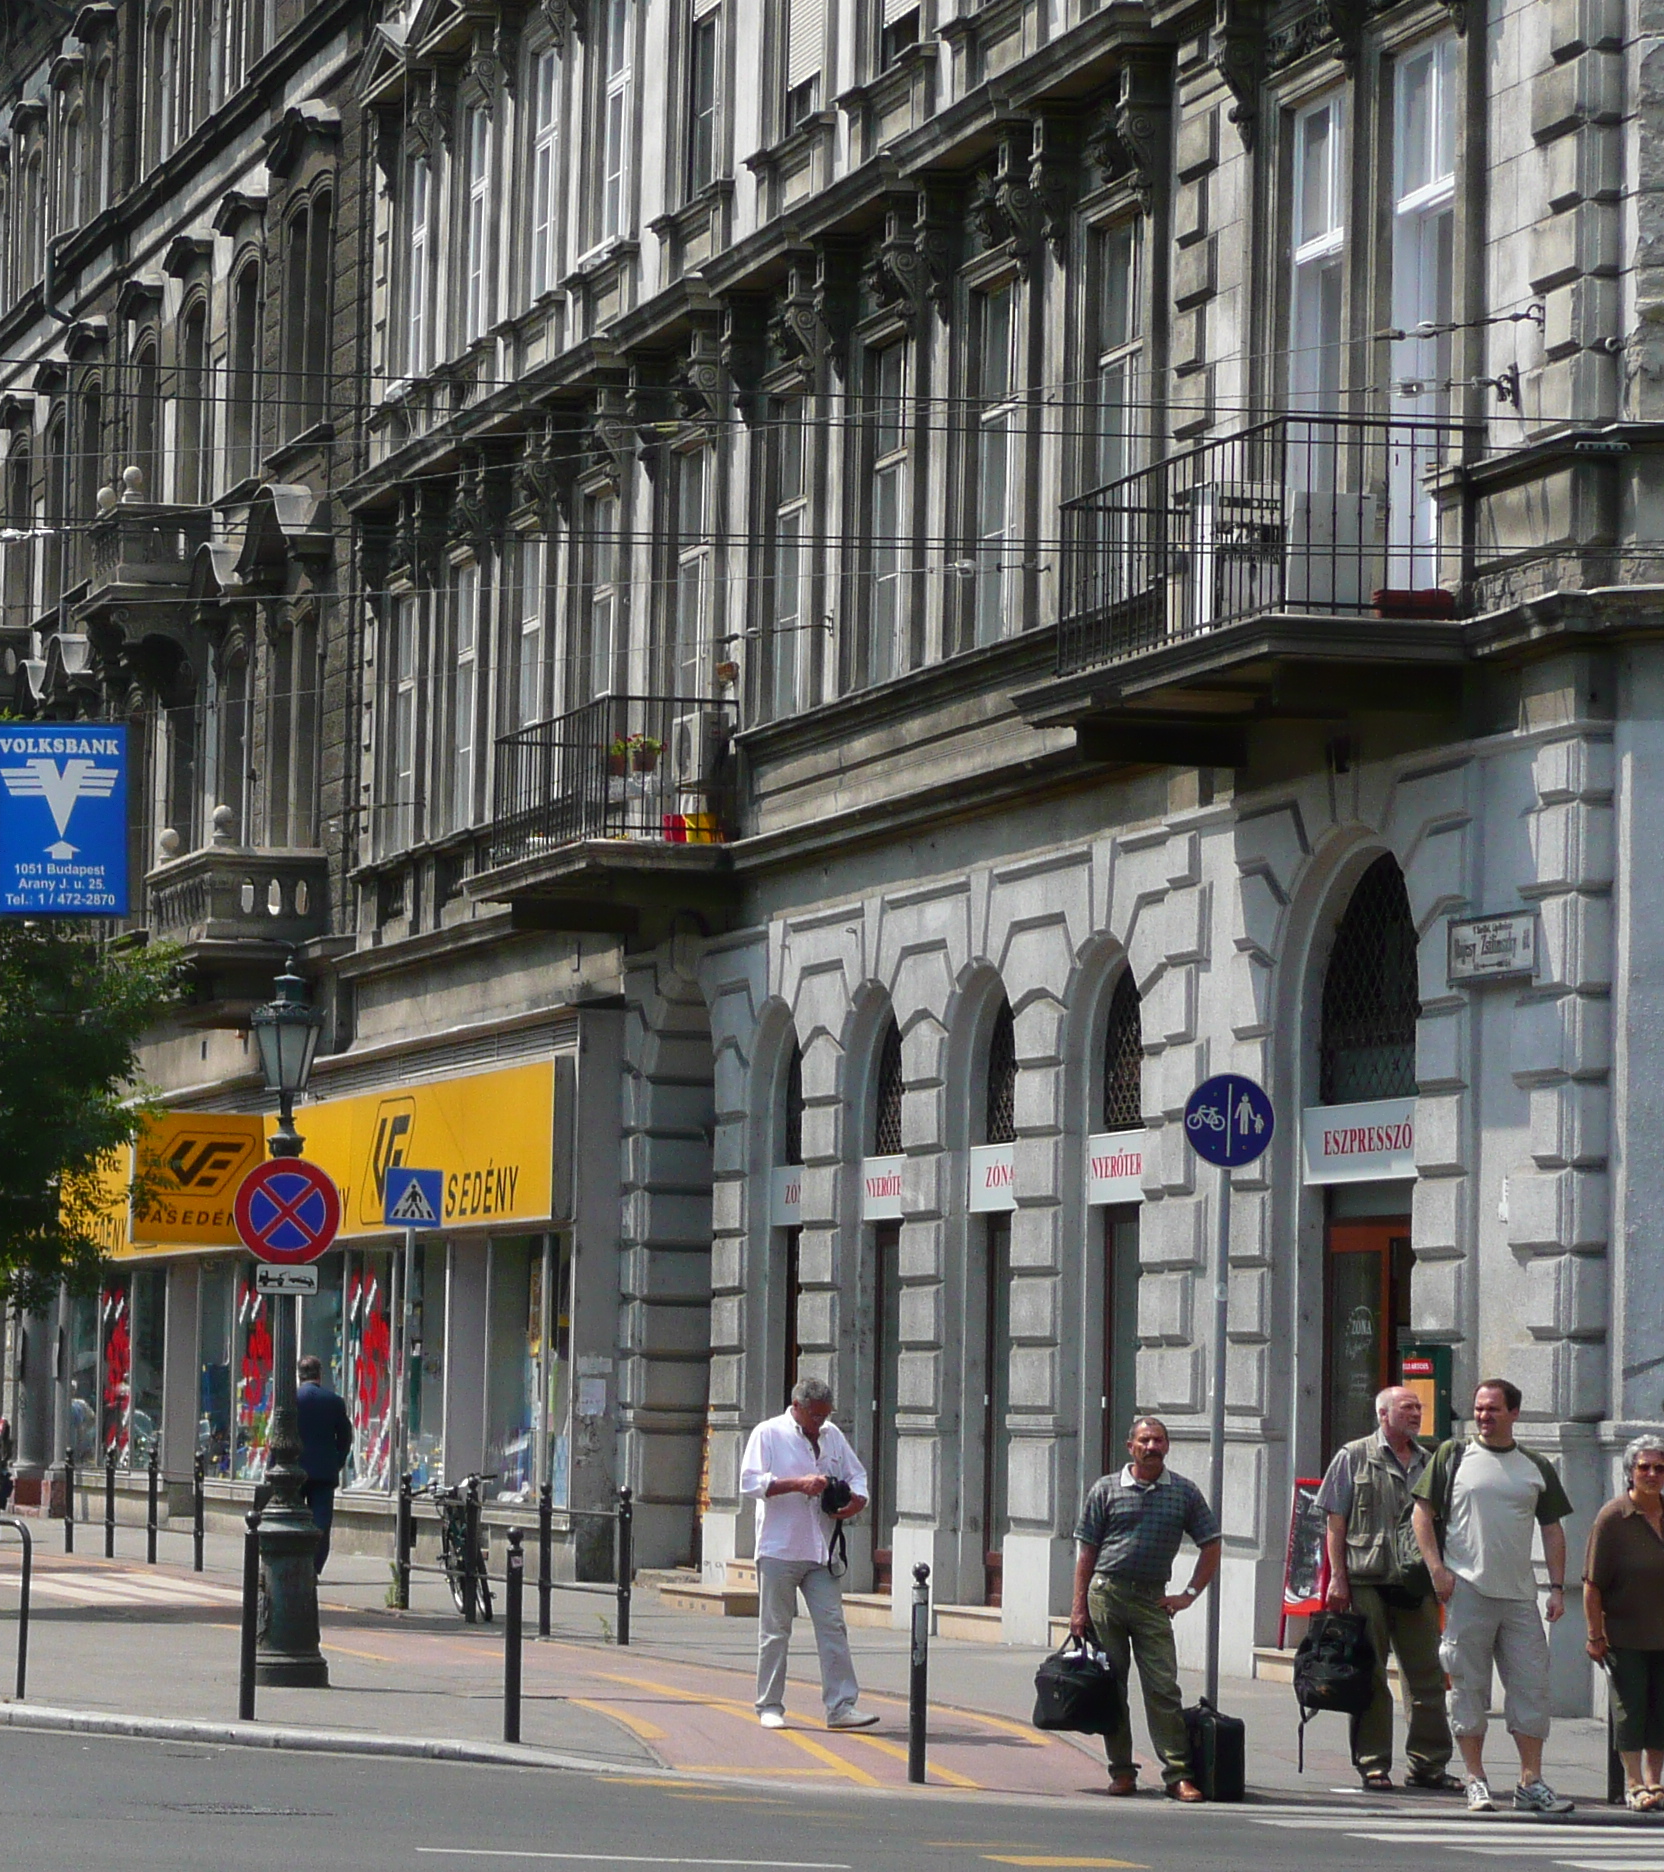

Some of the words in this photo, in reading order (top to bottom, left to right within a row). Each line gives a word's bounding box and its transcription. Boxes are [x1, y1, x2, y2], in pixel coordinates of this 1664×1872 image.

[15, 863, 42, 875] 1051
[47, 863, 105, 877] Budapest
[18, 879, 56, 891] Arany
[59, 879, 70, 889] J.
[74, 881, 85, 889] u.
[88, 879, 106, 890] 25.
[57, 894, 116, 905] 472-2870
[1323, 1115, 1413, 1156] ESZPRESSZÓ
[1091, 1147, 1142, 1181] NYERŐTER
[445, 1158, 519, 1218] SEDÉNY
